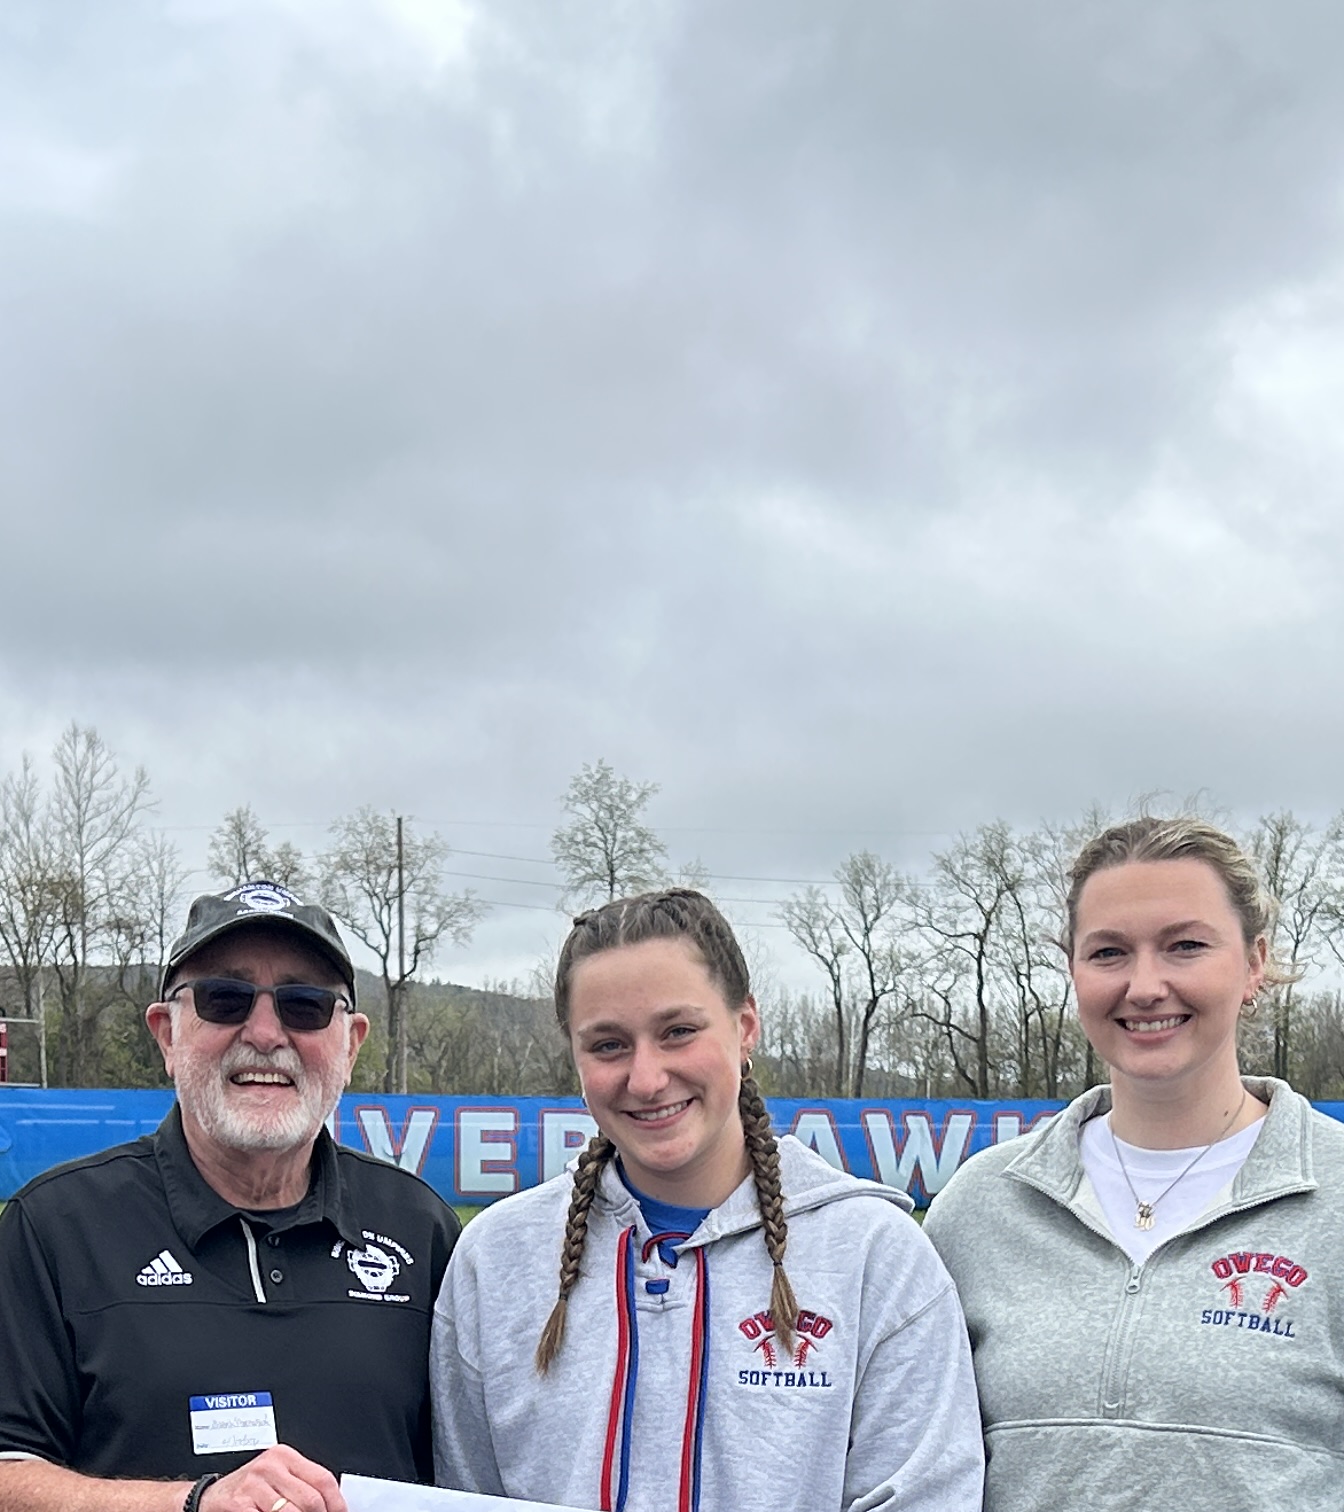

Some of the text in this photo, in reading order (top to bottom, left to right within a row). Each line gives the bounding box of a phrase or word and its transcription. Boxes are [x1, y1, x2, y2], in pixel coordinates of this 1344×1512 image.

[135, 1270, 193, 1287] adidas
[1211, 1251, 1308, 1287] OWEGO
[738, 1309, 833, 1340] OWGO
[1201, 1309, 1296, 1338] SOFTBALL
[738, 1370, 832, 1388] SOFTBALL
[205, 1394, 257, 1409] VISITOR
